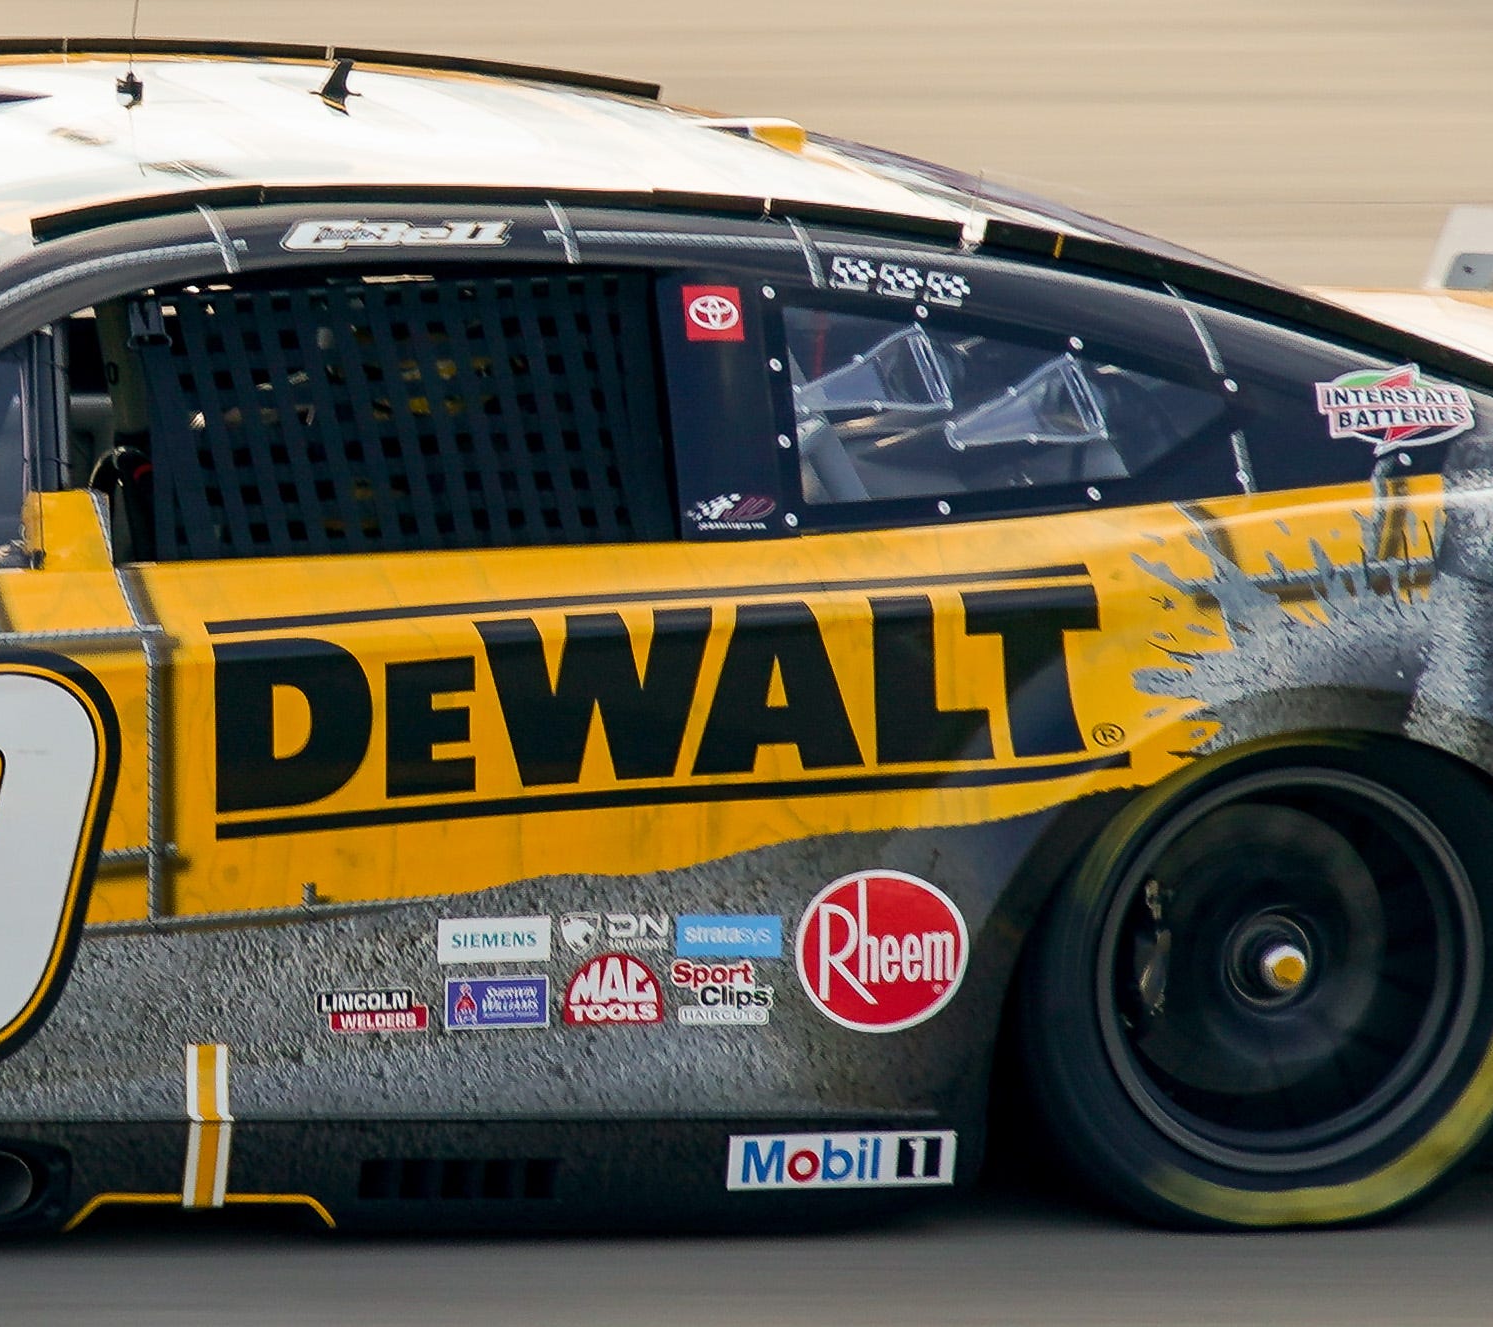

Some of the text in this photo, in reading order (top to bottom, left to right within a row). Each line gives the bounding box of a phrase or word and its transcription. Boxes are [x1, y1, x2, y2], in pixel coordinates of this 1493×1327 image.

[1325, 387, 1464, 406] INTERSTATE
[1339, 407, 1465, 429] BATTERIES
[450, 931, 538, 950] SIEMENS
[683, 924, 772, 945] stratasys
[818, 878, 956, 1006] Rheem
[568, 955, 658, 1004] MAC
[671, 960, 755, 989] Sport
[320, 990, 409, 1013] LINCOLN
[700, 986, 771, 1009] Clips
[339, 1011, 418, 1031] WELDERS
[569, 1002, 659, 1022] TOOLS
[681, 1008, 768, 1022] HAIRCUTS
[741, 1137, 882, 1184] Mobil
